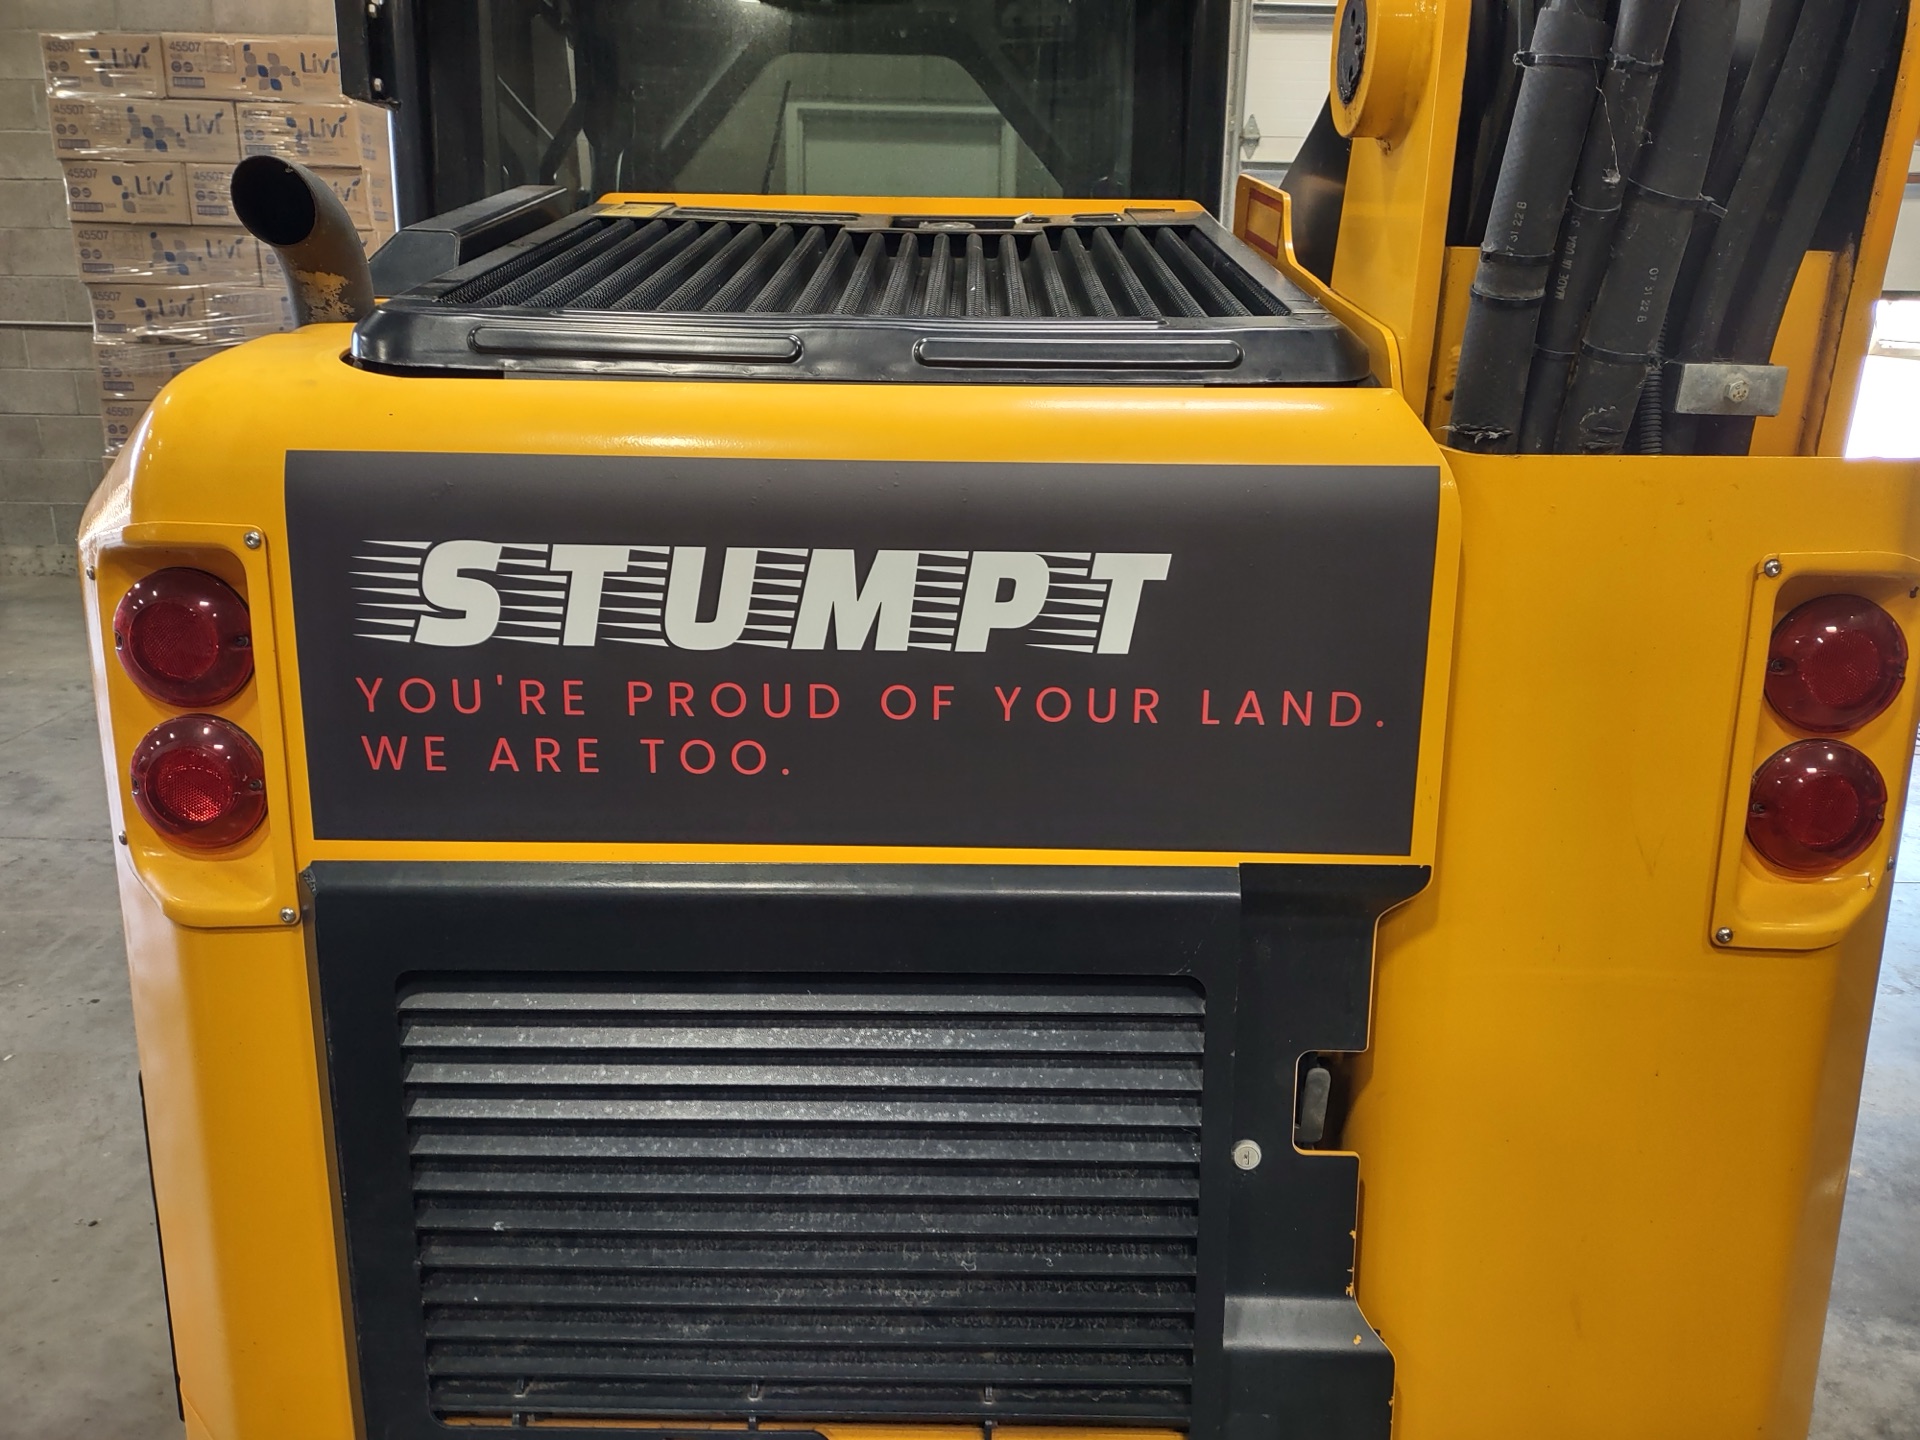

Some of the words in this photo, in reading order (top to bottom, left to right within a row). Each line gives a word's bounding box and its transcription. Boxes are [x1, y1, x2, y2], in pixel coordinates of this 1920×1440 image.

[111, 43, 151, 69] Livi
[169, 41, 201, 51] 45507
[300, 48, 338, 75] Livi
[54, 104, 85, 115] 45507
[185, 109, 224, 135] Livi
[309, 112, 349, 139] Livi
[67, 168, 98, 179] 45507
[135, 170, 174, 197] Livi
[193, 171, 225, 181] 45507
[333, 178, 361, 202] ivi
[77, 230, 109, 240] 45507
[206, 237, 244, 259] Livi
[1555, 273, 1570, 300] MADE
[1565, 235, 1578, 255] USA
[92, 291, 121, 301] 45507
[158, 294, 194, 318] Livi
[105, 406, 134, 417] 45507
[349, 540, 1173, 656] STUMPT
[355, 674, 585, 716] YOU'RE
[627, 681, 841, 719] PROUD
[881, 684, 955, 721] OF
[994, 686, 1161, 724] YOUR
[1200, 689, 1385, 728] LAND.
[360, 735, 448, 772] WE
[489, 737, 600, 774] ARE
[639, 738, 791, 777] TOO.
